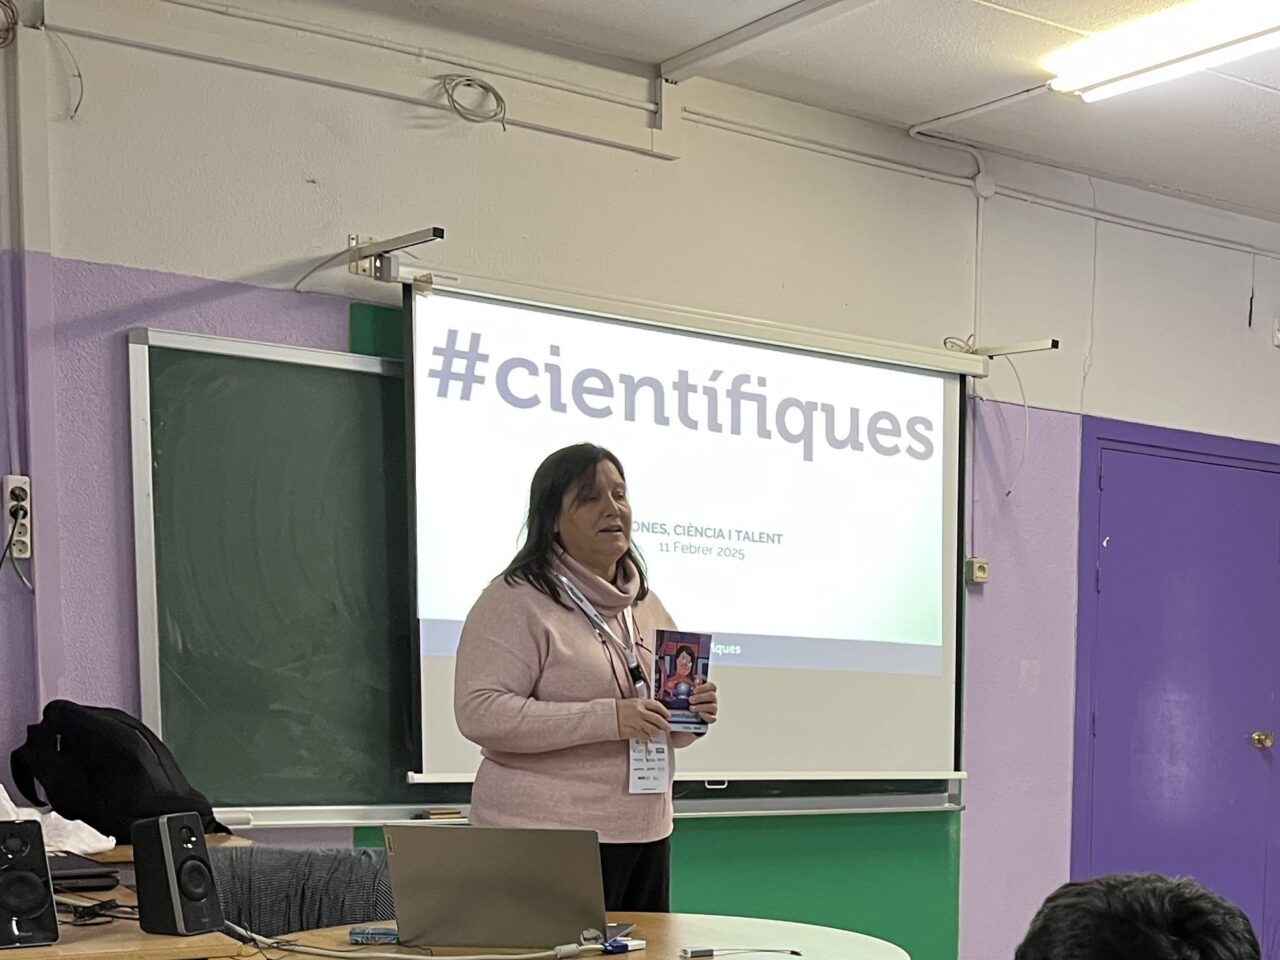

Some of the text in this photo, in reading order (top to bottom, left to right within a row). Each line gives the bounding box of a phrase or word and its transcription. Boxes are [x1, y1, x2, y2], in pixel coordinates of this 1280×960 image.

[428, 328, 935, 462] #científiques
[632, 521, 784, 545] ONES, CIÈNCIA I TALENT
[658, 541, 746, 561] 11 Febrer 2025
